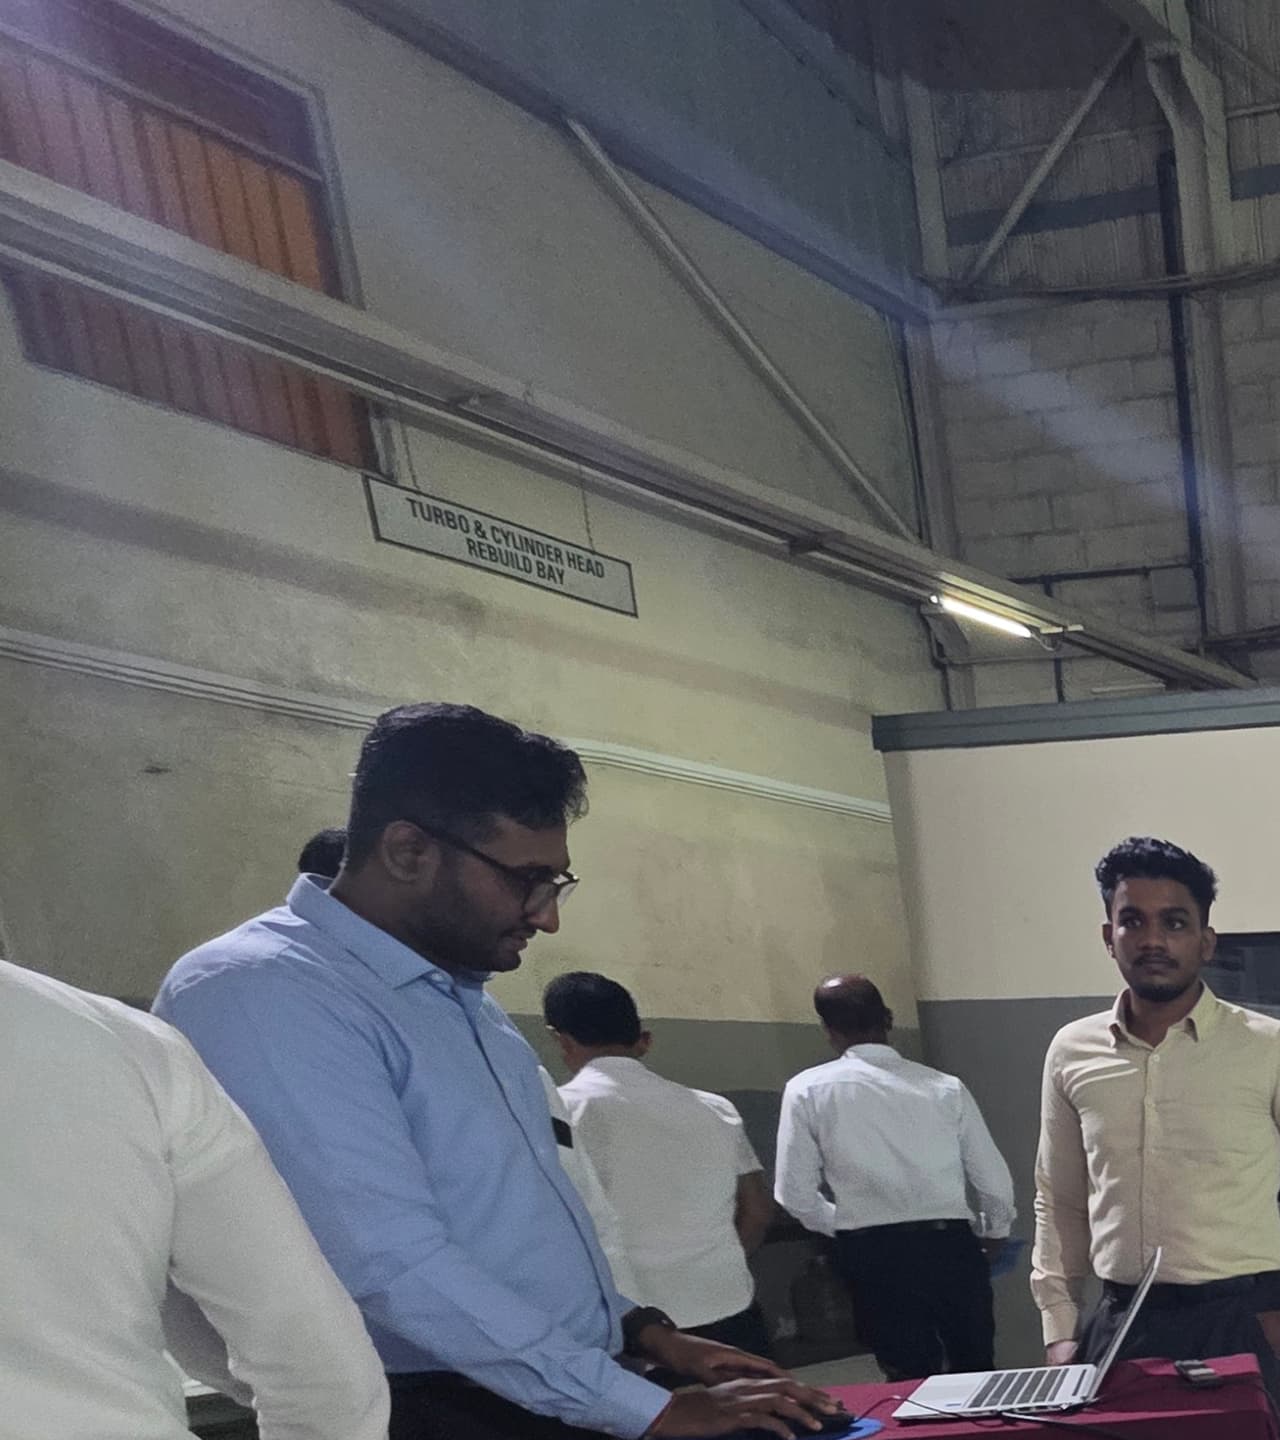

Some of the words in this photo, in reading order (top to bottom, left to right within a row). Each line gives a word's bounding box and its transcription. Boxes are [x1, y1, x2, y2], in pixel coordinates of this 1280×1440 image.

[406, 497, 469, 534] TURBO
[474, 520, 487, 538] &
[491, 525, 564, 565] CYLINDER
[566, 550, 605, 578] HEAD
[466, 538, 533, 573] REBUILD
[536, 563, 565, 585] BAY
